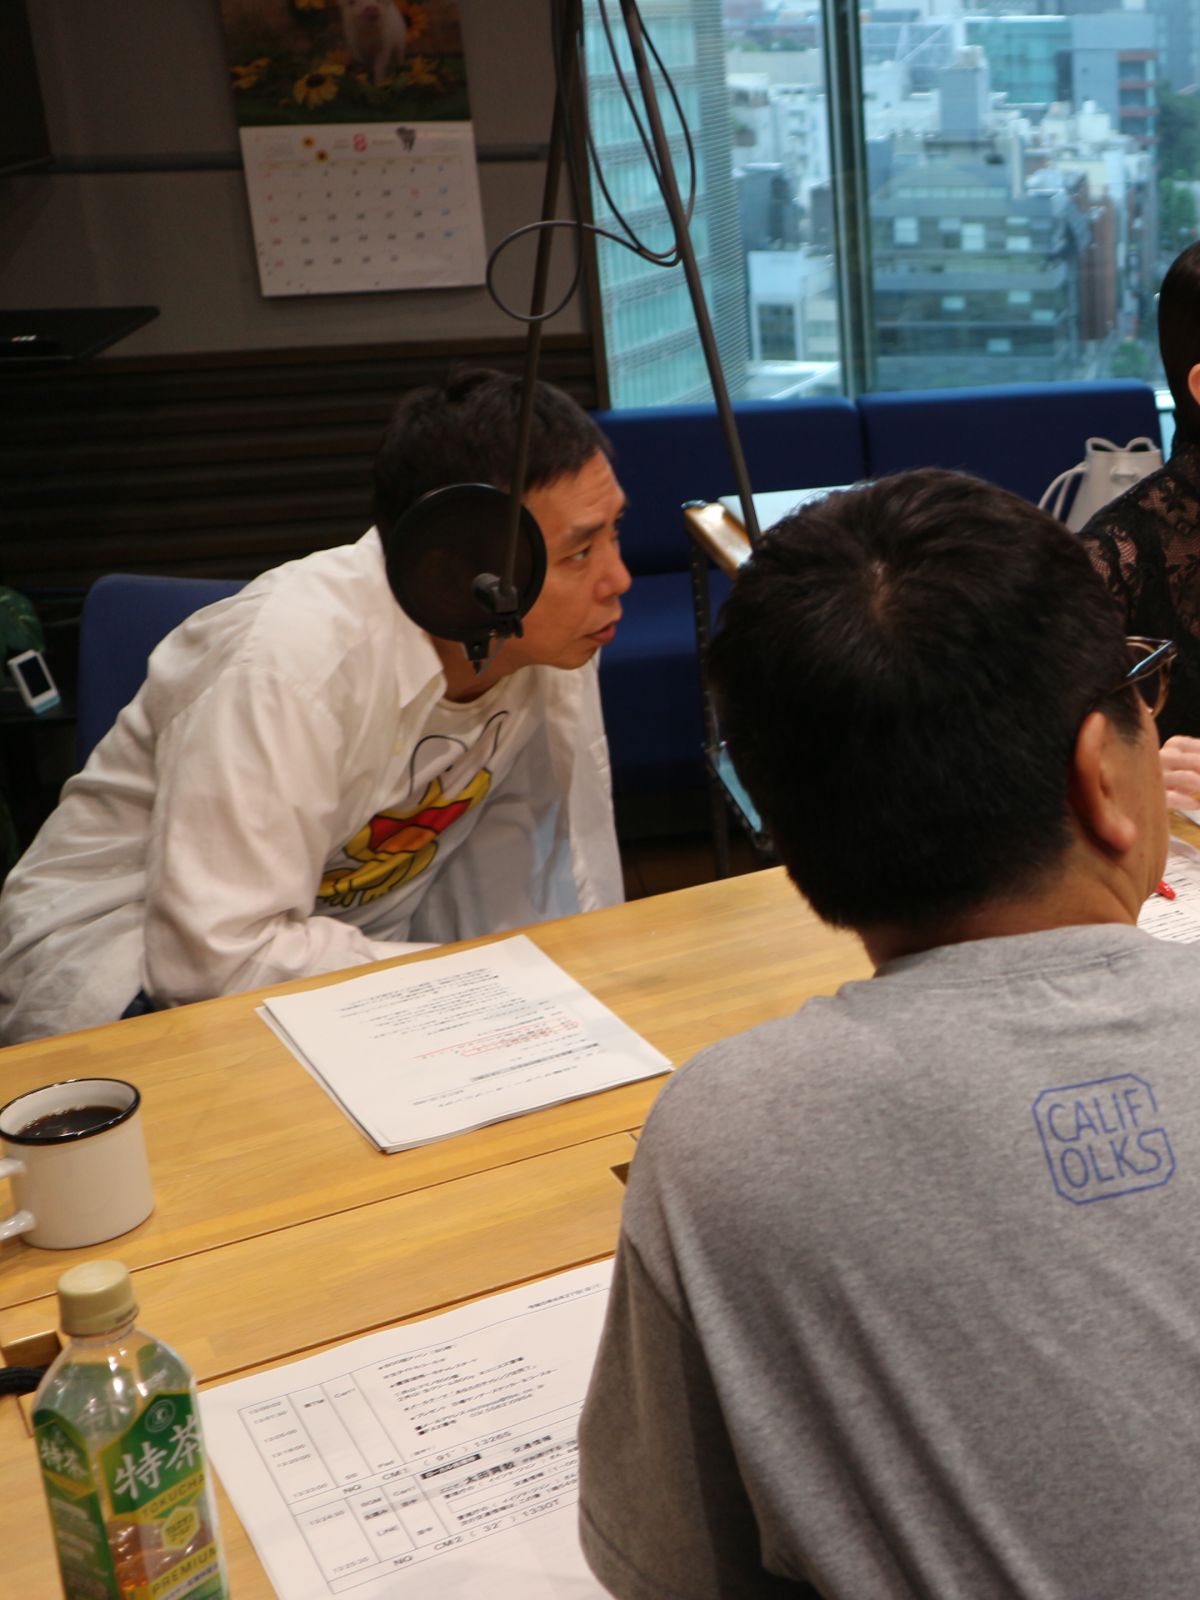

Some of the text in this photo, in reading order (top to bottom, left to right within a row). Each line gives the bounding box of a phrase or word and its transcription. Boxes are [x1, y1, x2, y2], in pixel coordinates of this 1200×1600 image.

[1047, 1088, 1143, 1142] CALIF
[1060, 1128, 1163, 1189] OLKS
[114, 1413, 204, 1500] 特茶
